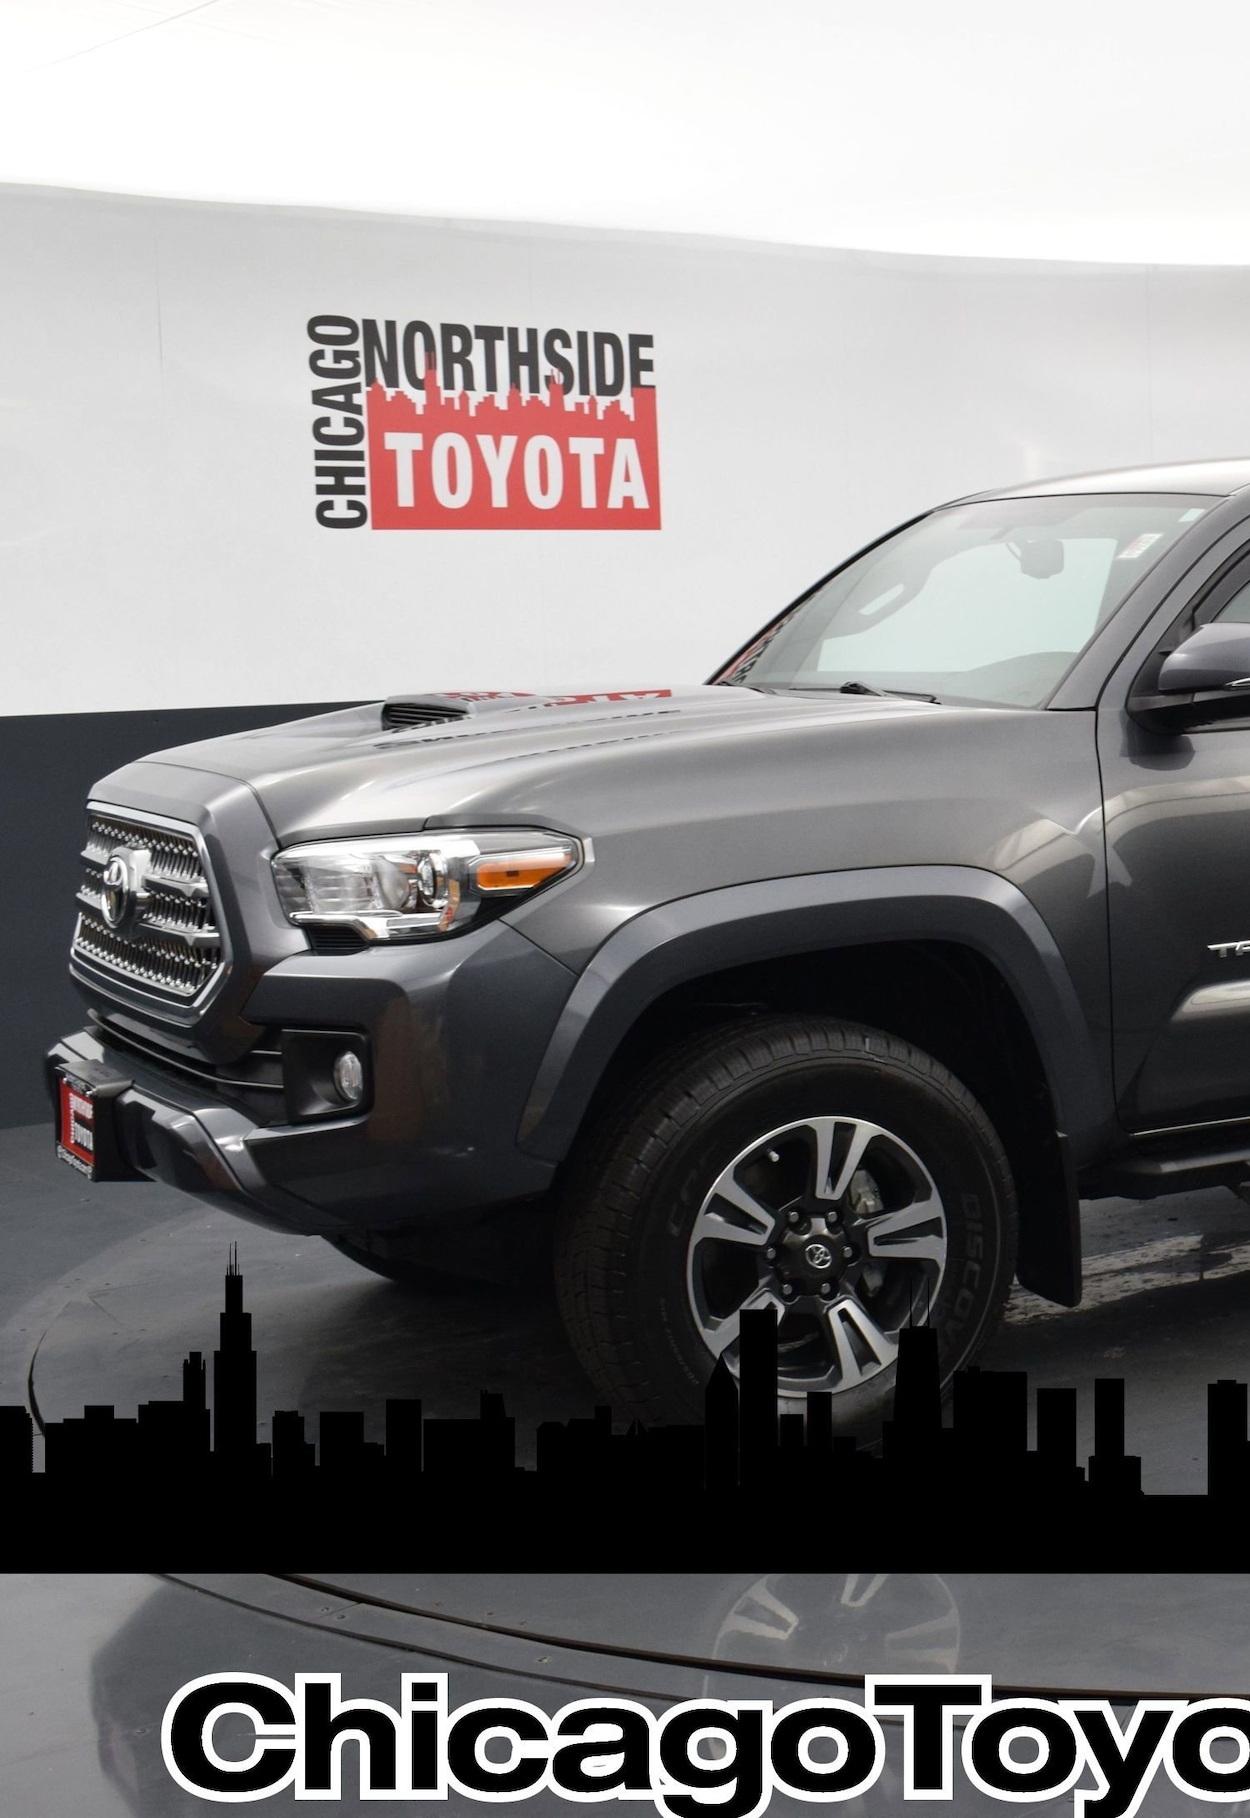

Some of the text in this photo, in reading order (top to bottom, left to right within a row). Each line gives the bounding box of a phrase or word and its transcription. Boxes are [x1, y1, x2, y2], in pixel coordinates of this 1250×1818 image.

[362, 318, 656, 397] NORTHSIDE
[307, 314, 368, 530] CHICAGO
[383, 431, 650, 510] TOYOTA
